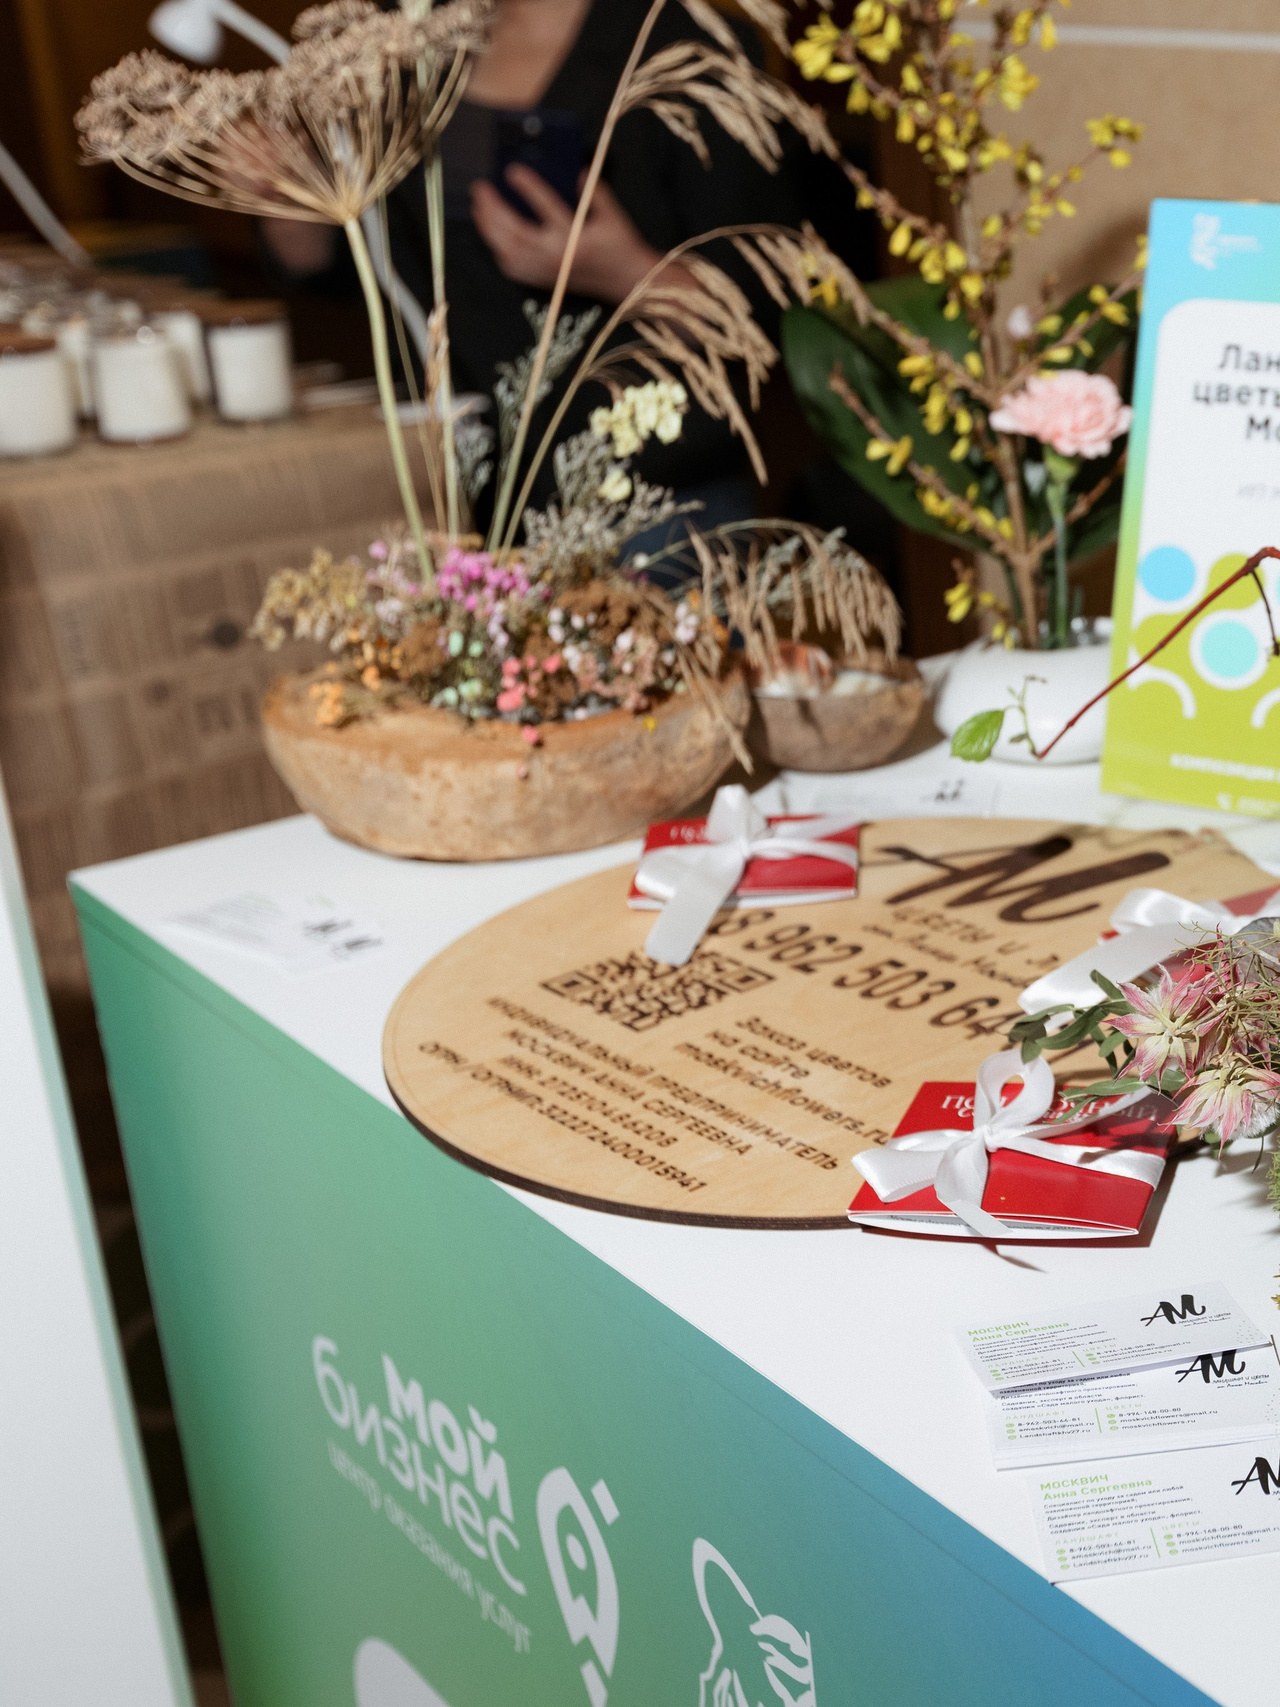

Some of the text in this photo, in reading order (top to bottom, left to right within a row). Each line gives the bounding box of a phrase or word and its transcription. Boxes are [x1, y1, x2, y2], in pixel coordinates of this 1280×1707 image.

[707, 909, 1026, 1041] 8 962 503 64
[486, 997, 839, 1172] ИНДИВИДУАЛЬНЫЙ ПРЕДПРИНИМАТЕЛЬ
[704, 1030, 811, 1080] на сайте
[735, 1016, 892, 1089] Заказ цветов
[502, 1029, 753, 1157] МОСКВИЧ АННА СЕРГЕЕВНА
[537, 1076, 679, 1148] 272510486208
[673, 1041, 891, 1146] moskvichflowers.ru
[968, 1321, 1030, 1336] МОСКВИЧ
[972, 1322, 1070, 1342] Анна Сергеевна
[312, 1334, 527, 1597] бизнес
[382, 1352, 515, 1523] мой
[1040, 1474, 1109, 1491] МОСКВИЧ
[1043, 1479, 1152, 1500] Анна Сергеевна
